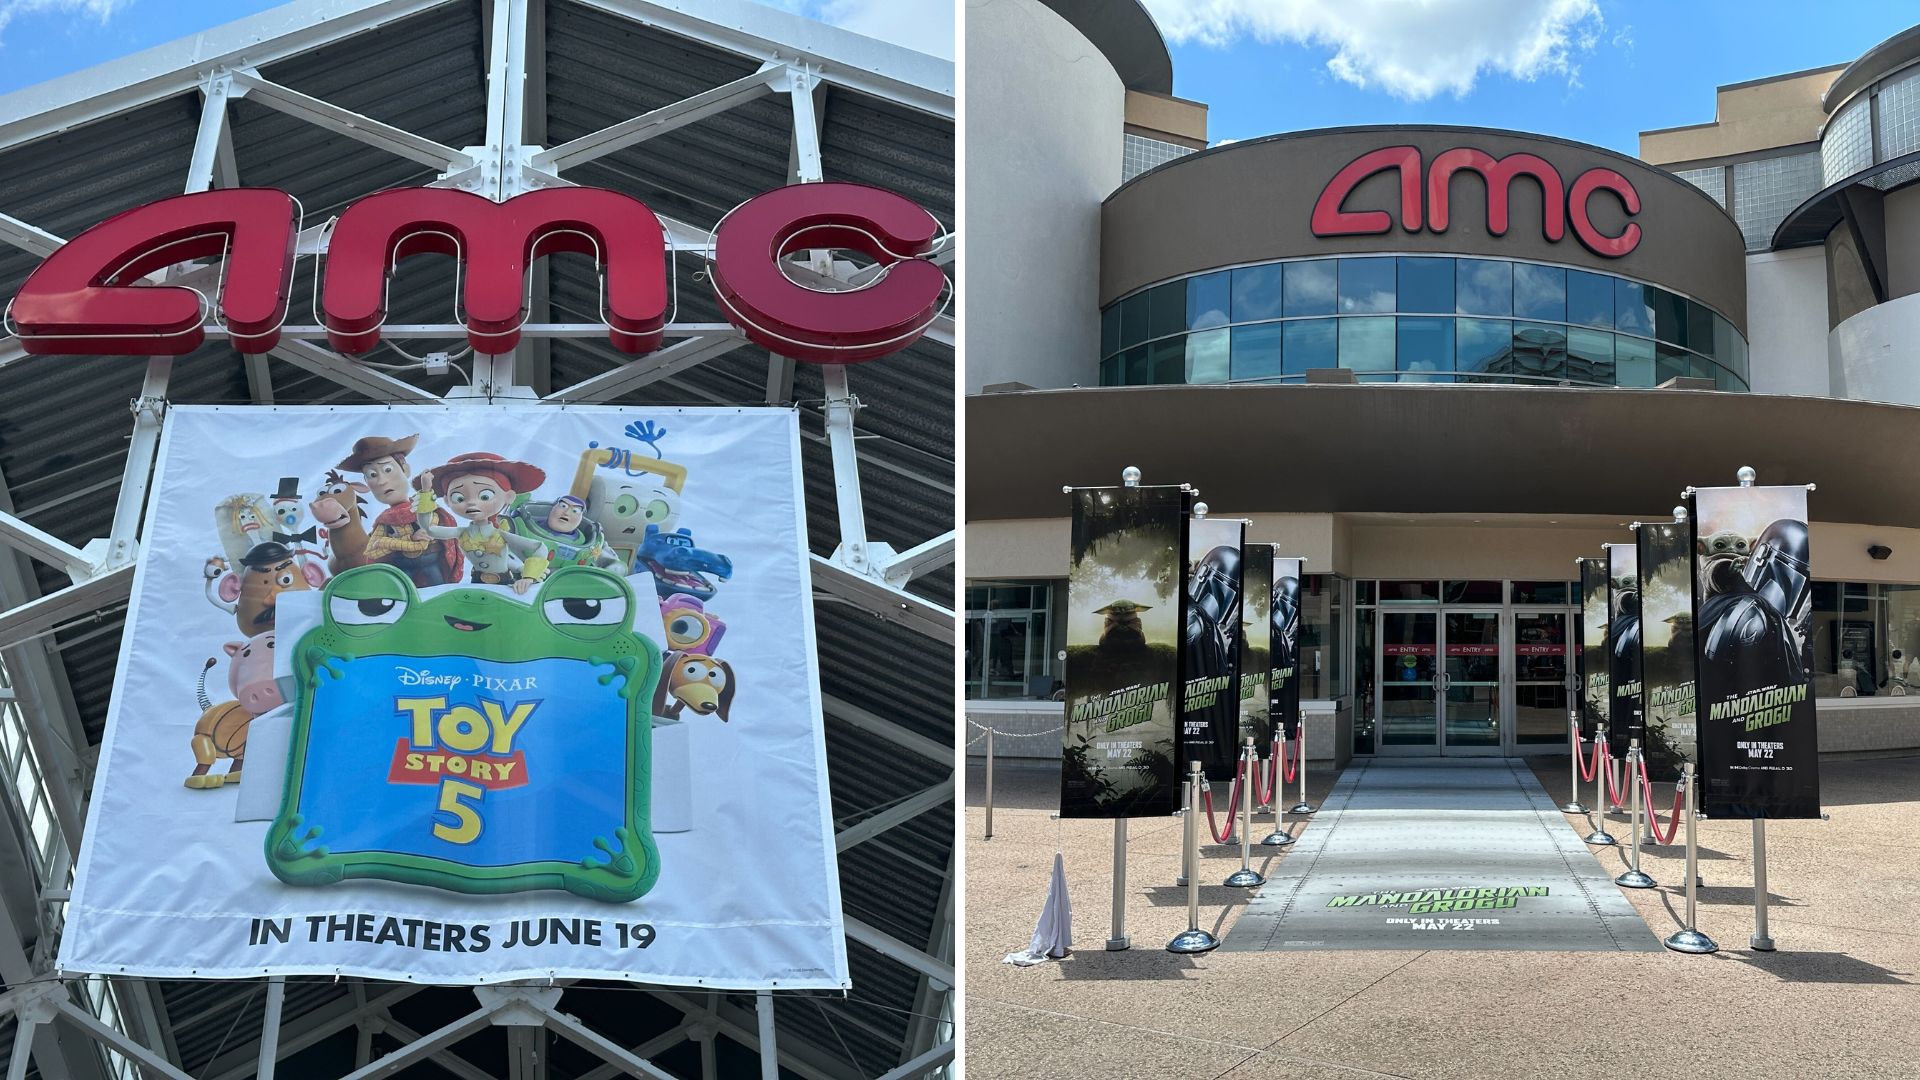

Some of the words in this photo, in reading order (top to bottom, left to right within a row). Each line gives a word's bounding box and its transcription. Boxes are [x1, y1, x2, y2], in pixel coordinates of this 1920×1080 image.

[395, 666, 462, 691] Disney
[471, 674, 538, 692] PIXAR
[1745, 688, 1761, 696] STAR
[1761, 684, 1778, 692] WARS
[1071, 682, 1169, 723] MANDALORIAN
[1184, 691, 1217, 713] ROGU
[1709, 683, 1807, 721] MANDALORIAN
[395, 694, 542, 757] TOY
[1106, 701, 1154, 733] GROGU
[1731, 716, 1745, 724] AND
[1745, 704, 1792, 732] GROGU
[1192, 727, 1200, 735] 22
[1107, 749, 1121, 758] MAY
[1122, 748, 1132, 758] 22
[1117, 741, 1143, 749] THEATERS
[1736, 741, 1750, 749] ONLY
[1750, 741, 1757, 749] IN
[1757, 741, 1784, 750] THEATERS
[1748, 749, 1762, 758] MAY
[1763, 749, 1774, 759] 22
[404, 753, 517, 782] STORY
[431, 777, 487, 846] 5
[1326, 886, 1550, 908] MANDALORIAN
[1408, 896, 1518, 914] GROGU
[248, 917, 293, 946] IN
[305, 913, 491, 953] THEATERS
[501, 918, 602, 949] JUNE
[614, 922, 657, 950] 19
[1411, 923, 1447, 931] MAY
[1451, 923, 1476, 931] 22
